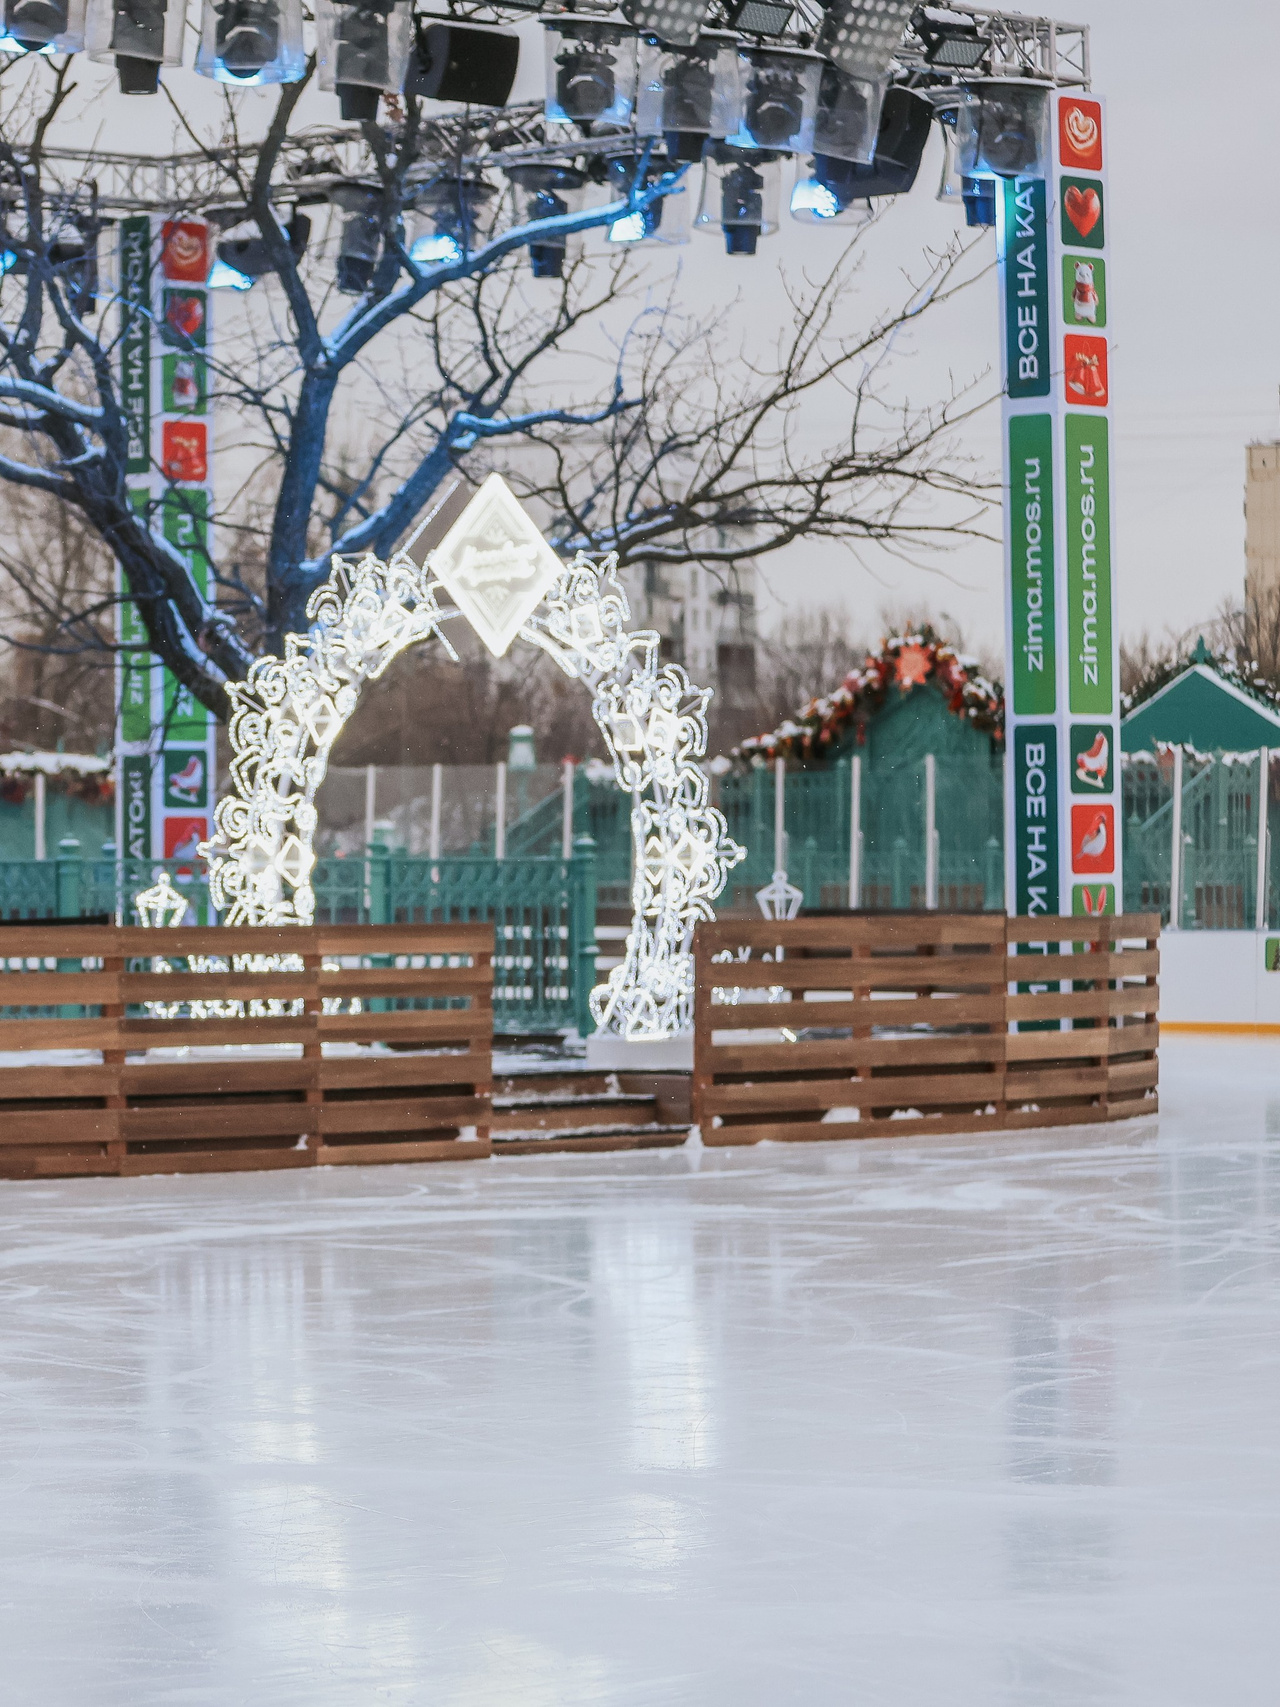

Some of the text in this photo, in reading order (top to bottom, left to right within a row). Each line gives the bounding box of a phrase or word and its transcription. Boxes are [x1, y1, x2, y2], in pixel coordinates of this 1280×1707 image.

[1015, 176, 1038, 380] ВСЕ НА КАТ
[128, 346, 144, 390] НА
[1023, 457, 1043, 673] zima.mos.ru
[1079, 444, 1098, 686] zima.mos.ru
[1025, 743, 1047, 818] ВСЕ
[1026, 826, 1048, 880] НА
